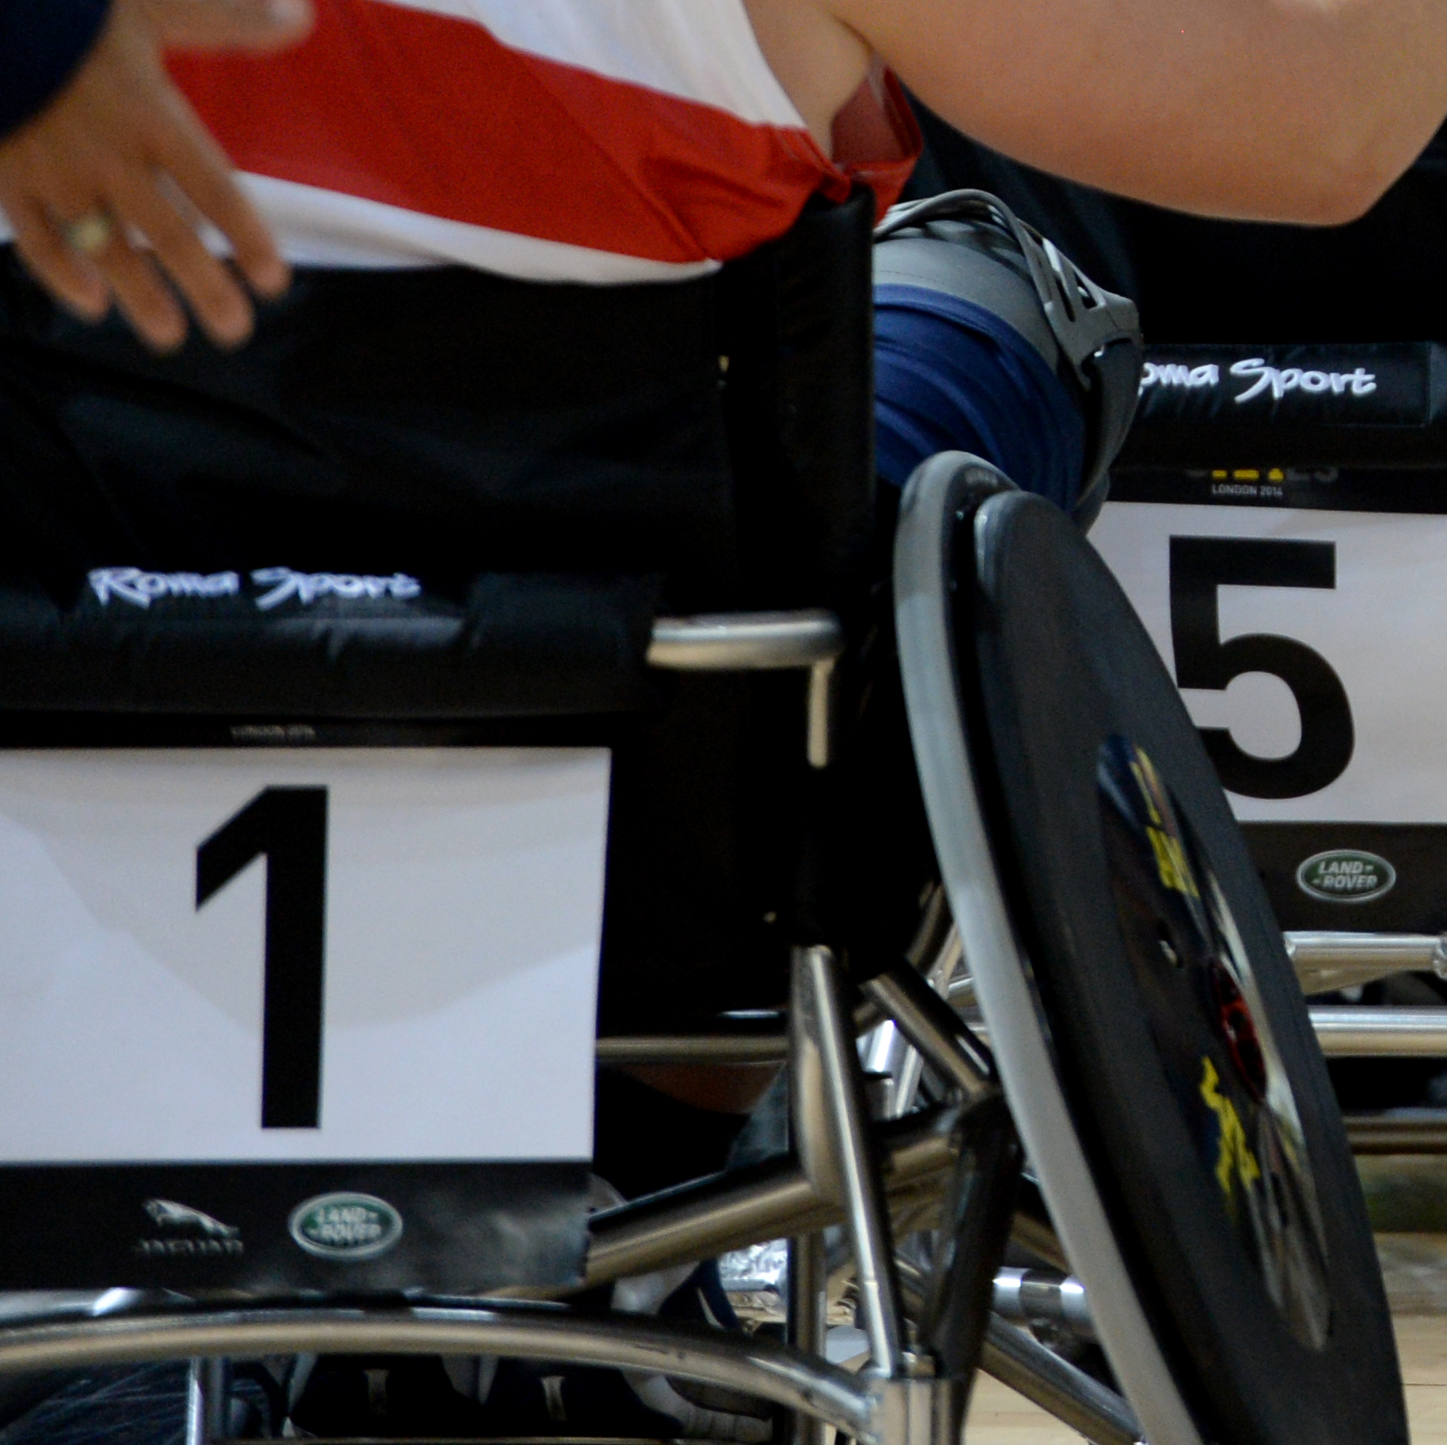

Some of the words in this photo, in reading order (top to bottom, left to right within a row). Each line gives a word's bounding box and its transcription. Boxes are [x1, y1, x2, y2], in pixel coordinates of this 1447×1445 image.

[1138, 362, 1219, 396] oma
[1229, 358, 1377, 403] Sport
[1212, 484, 1257, 496] LONDON
[88, 566, 241, 609] Roma
[251, 566, 422, 610] Sport
[1168, 535, 1356, 800] 5
[195, 785, 329, 1130] 1
